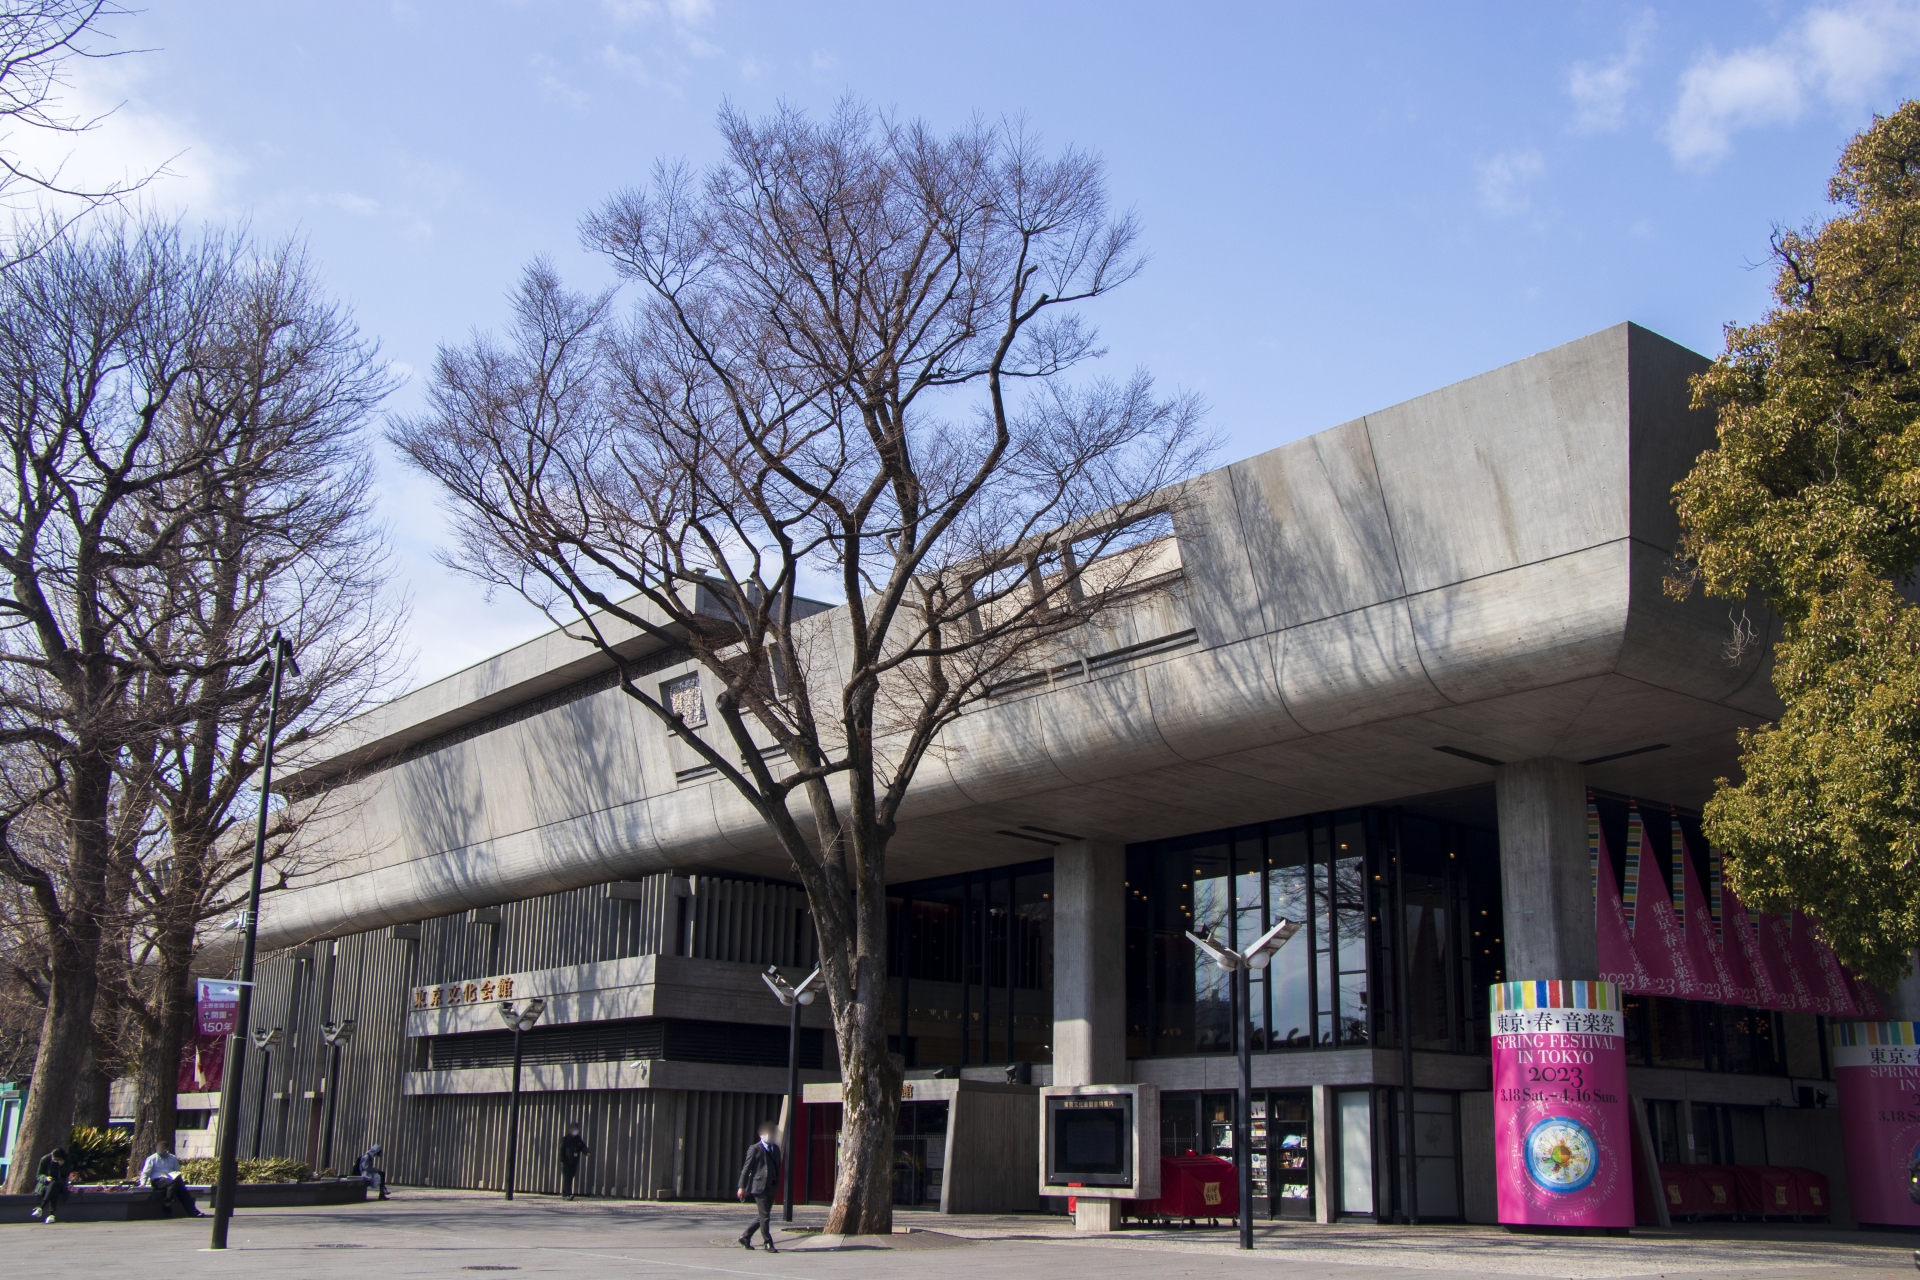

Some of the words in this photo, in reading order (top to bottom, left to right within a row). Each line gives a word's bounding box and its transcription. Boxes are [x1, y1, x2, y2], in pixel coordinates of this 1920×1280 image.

[1651, 901, 1694, 995] 東京・春・音楽祭
[1695, 907, 1735, 999] 東京・春・音楽祭
[1599, 973, 1635, 990] 2023
[413, 977, 513, 1008] 東京文化会館
[202, 1022, 233, 1032] 150年
[1497, 1012, 1615, 1033] 東京・春・音楽祭
[1497, 1034, 1544, 1049] SPRING
[1549, 1034, 1616, 1050] FESTIVAL
[1518, 1050, 1533, 1064] IN
[1537, 1049, 1594, 1065] TOKYO
[1528, 1067, 1583, 1089] 2023
[1900, 1079, 1916, 1091] IN
[1500, 1088, 1520, 1102] 3.18
[1593, 1088, 1618, 1104] Sun.
[1878, 1110, 1905, 1122] 3.18
